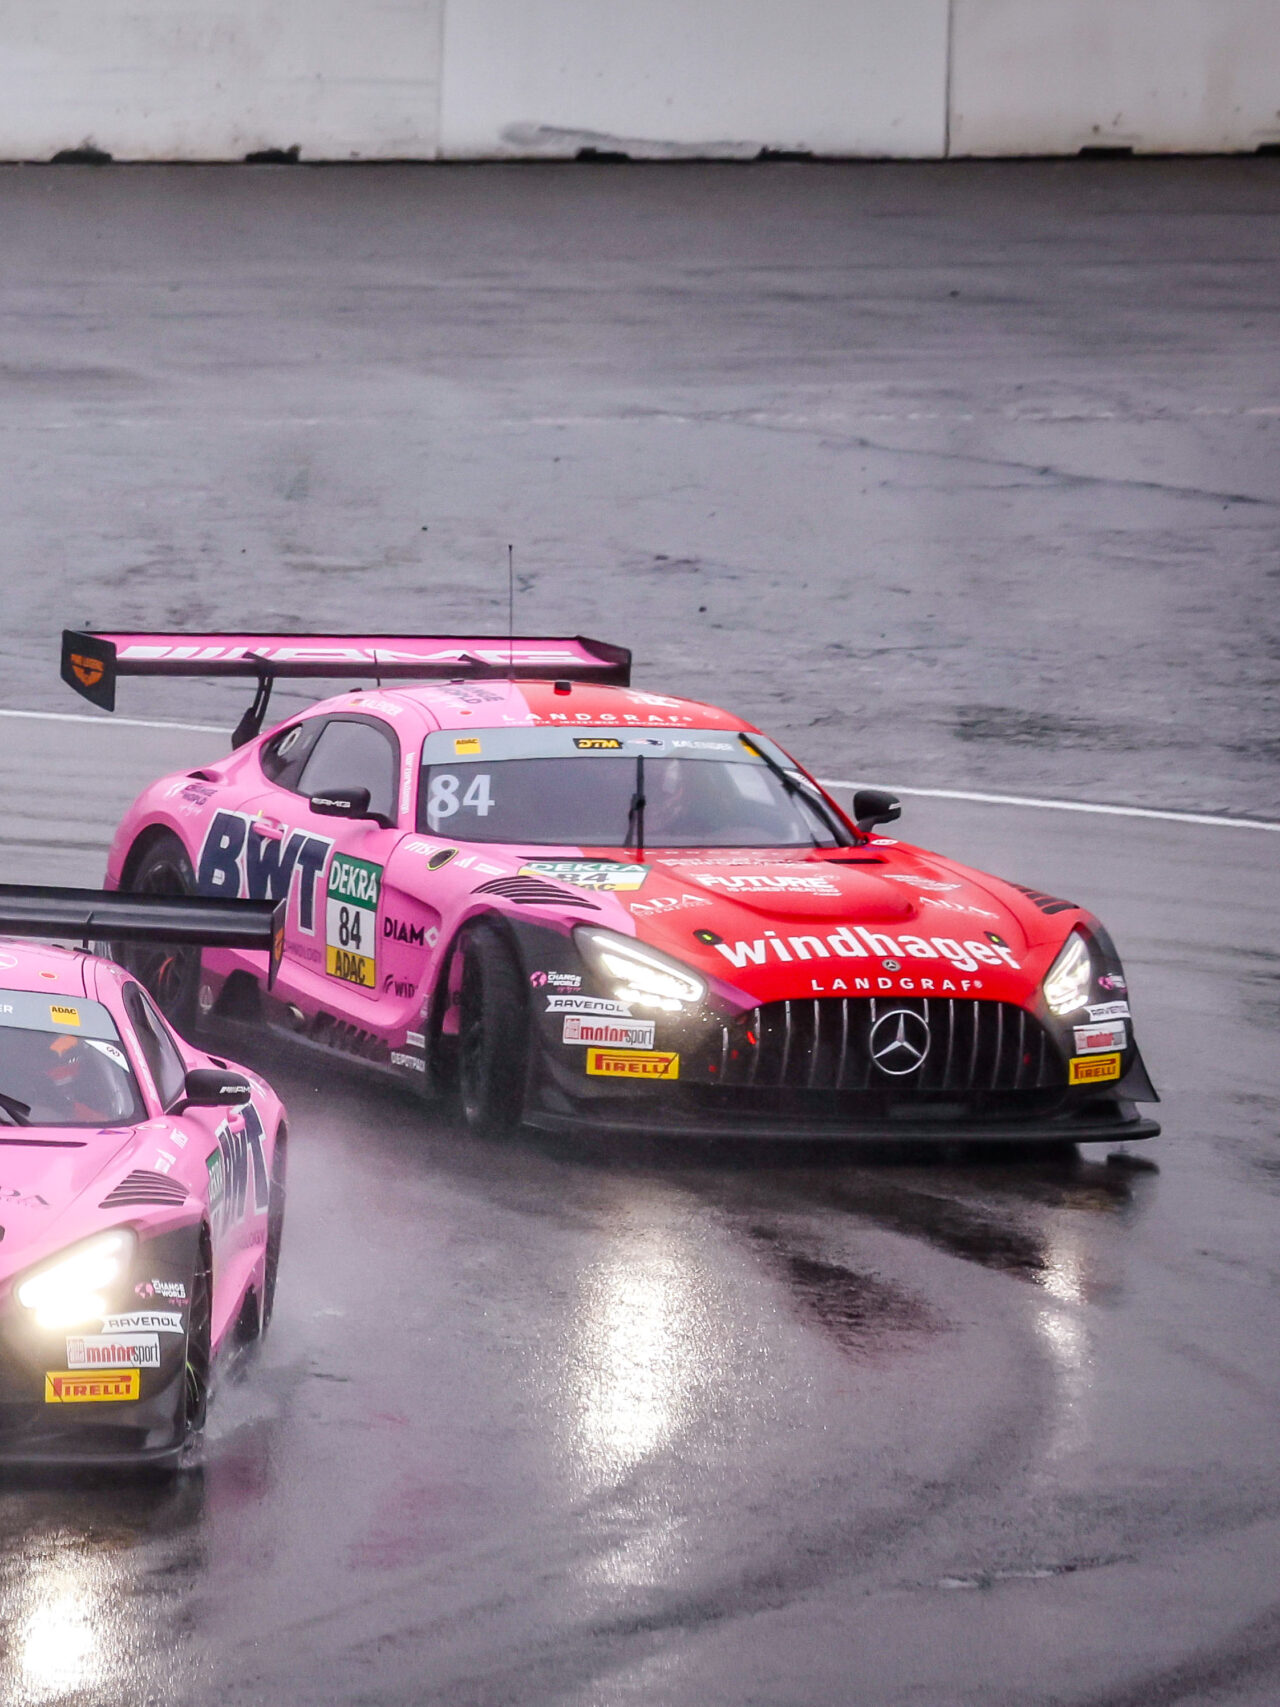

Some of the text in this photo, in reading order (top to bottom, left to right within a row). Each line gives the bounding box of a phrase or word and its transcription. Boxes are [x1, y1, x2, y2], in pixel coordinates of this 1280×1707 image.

[502, 712, 677, 723] LANDGRAF
[578, 738, 621, 749] DTM
[428, 774, 495, 818] 84
[197, 808, 336, 936] BWT
[529, 863, 643, 873] DEKRA
[556, 871, 611, 884] 84
[329, 862, 378, 903] DEKRA
[695, 876, 836, 889] FUTURE
[338, 906, 362, 950] 84
[719, 926, 1022, 973] windhager
[334, 949, 367, 985] ADAC
[51, 1006, 77, 1016] ADAC
[554, 999, 624, 1013] RAVENOL
[580, 1025, 652, 1046] motorsport
[594, 1053, 670, 1075] PIRELLI
[1074, 1057, 1117, 1080] PIRELLI
[108, 1316, 178, 1328] RAVENOL
[86, 1343, 160, 1365] motorsport
[53, 1374, 132, 1398] PIRELLI
